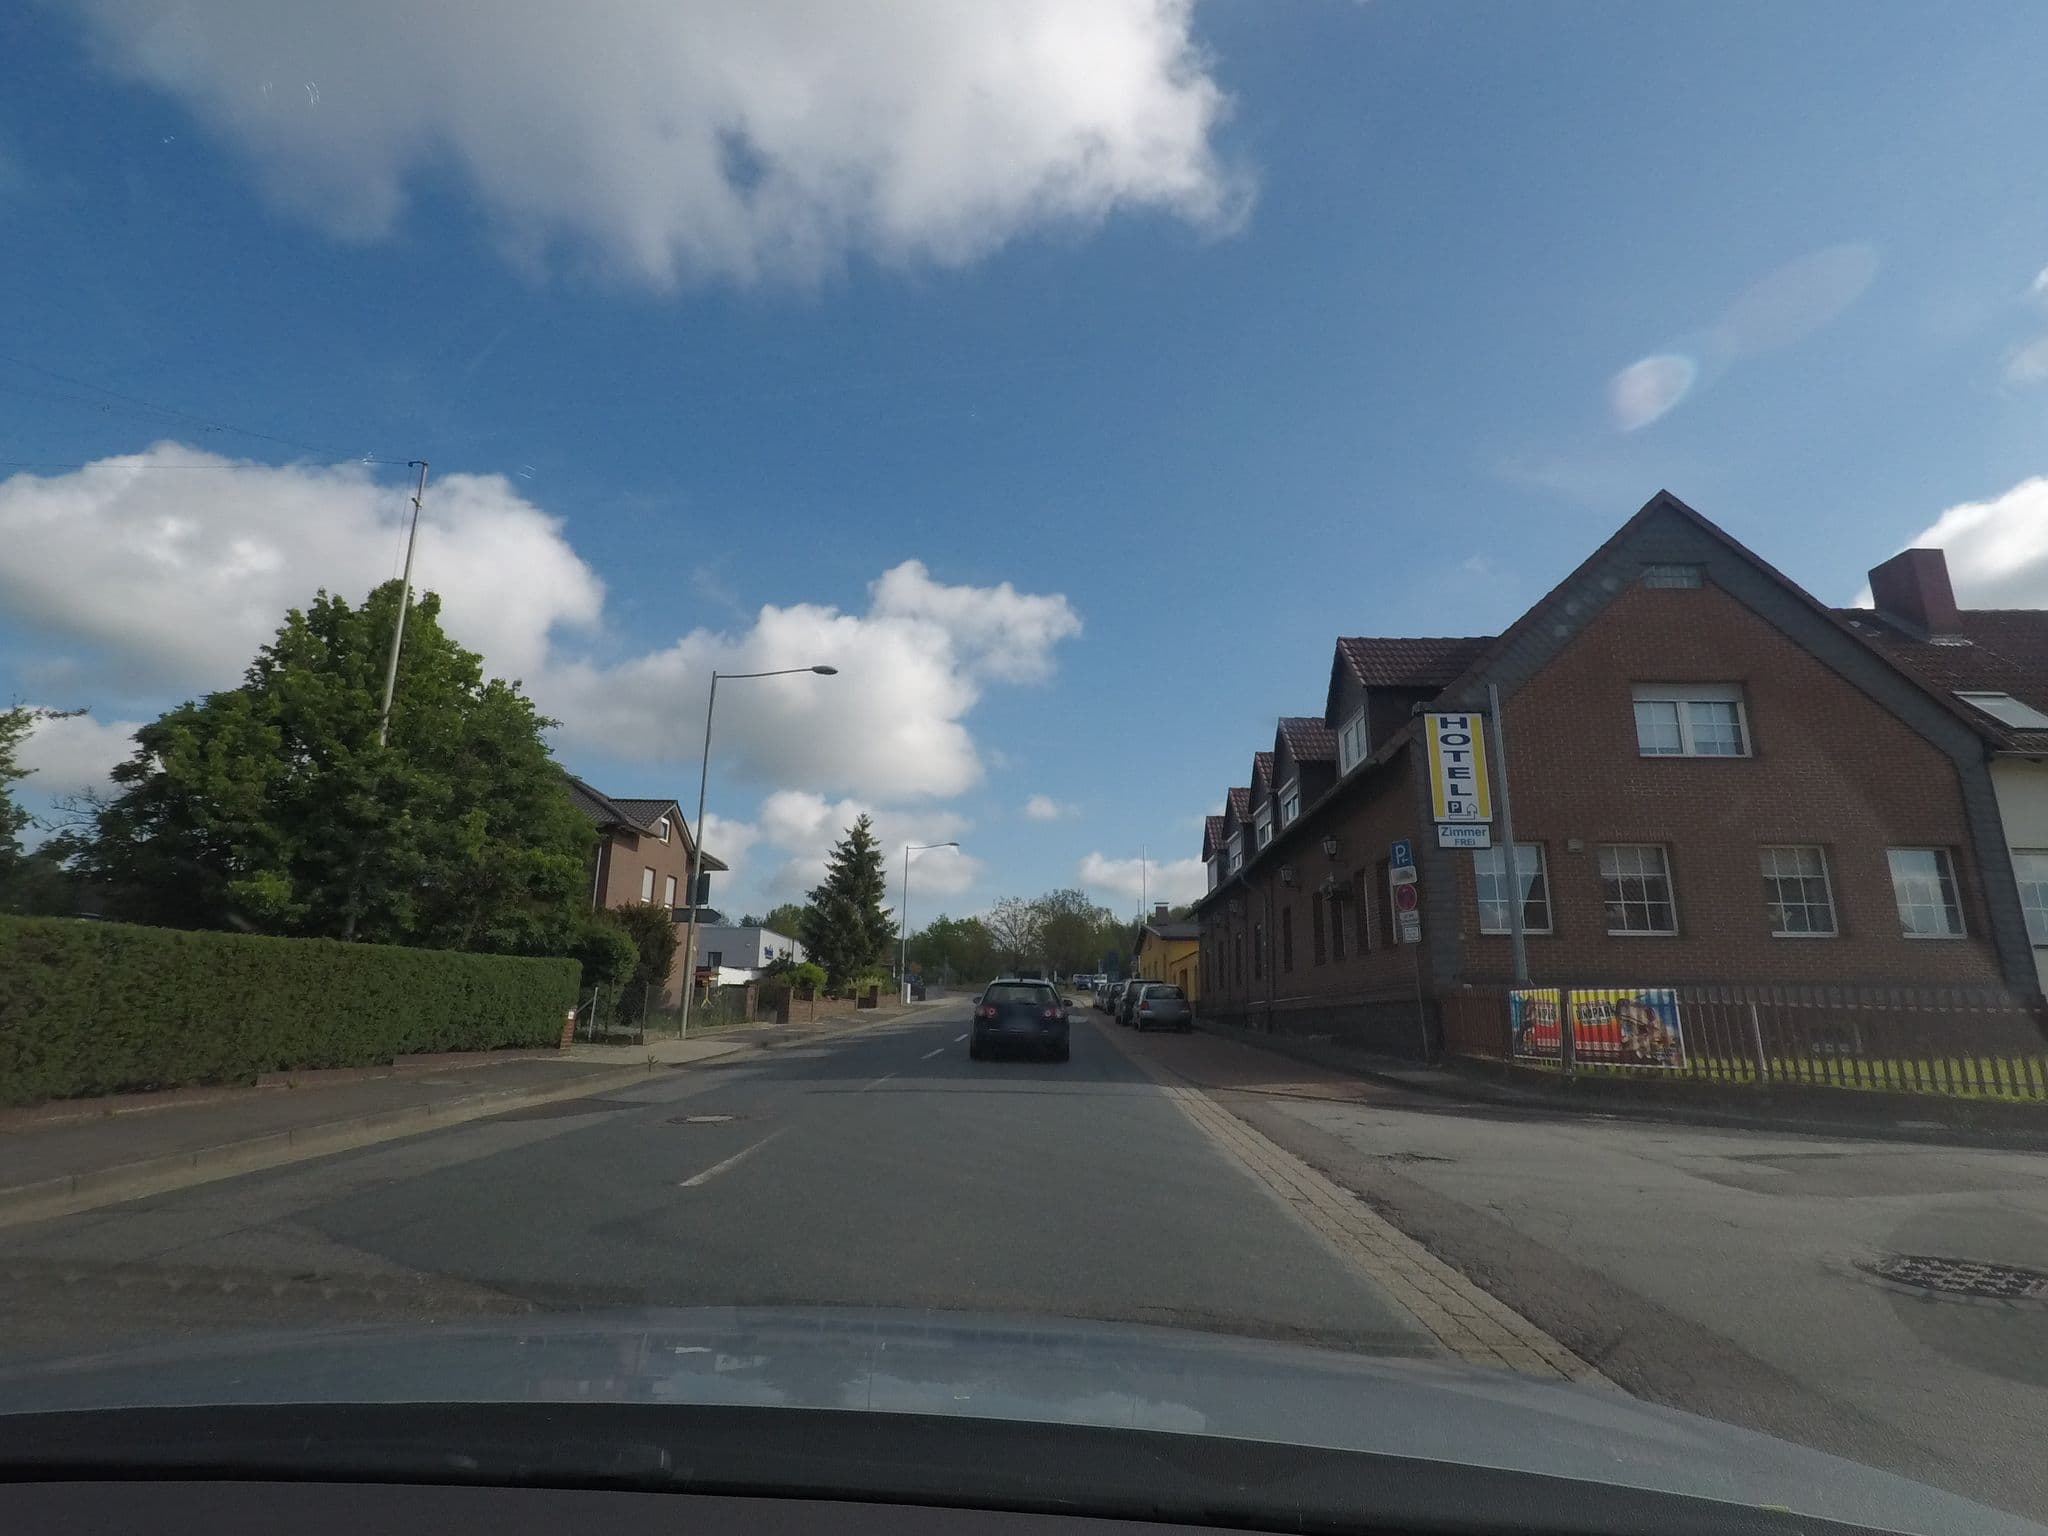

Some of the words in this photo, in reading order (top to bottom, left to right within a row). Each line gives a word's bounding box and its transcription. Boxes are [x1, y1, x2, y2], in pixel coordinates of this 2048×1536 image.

[1440, 716, 1472, 797] HOTEL
[1441, 826, 1487, 837] Zimmer
[1395, 844, 1406, 864] P
